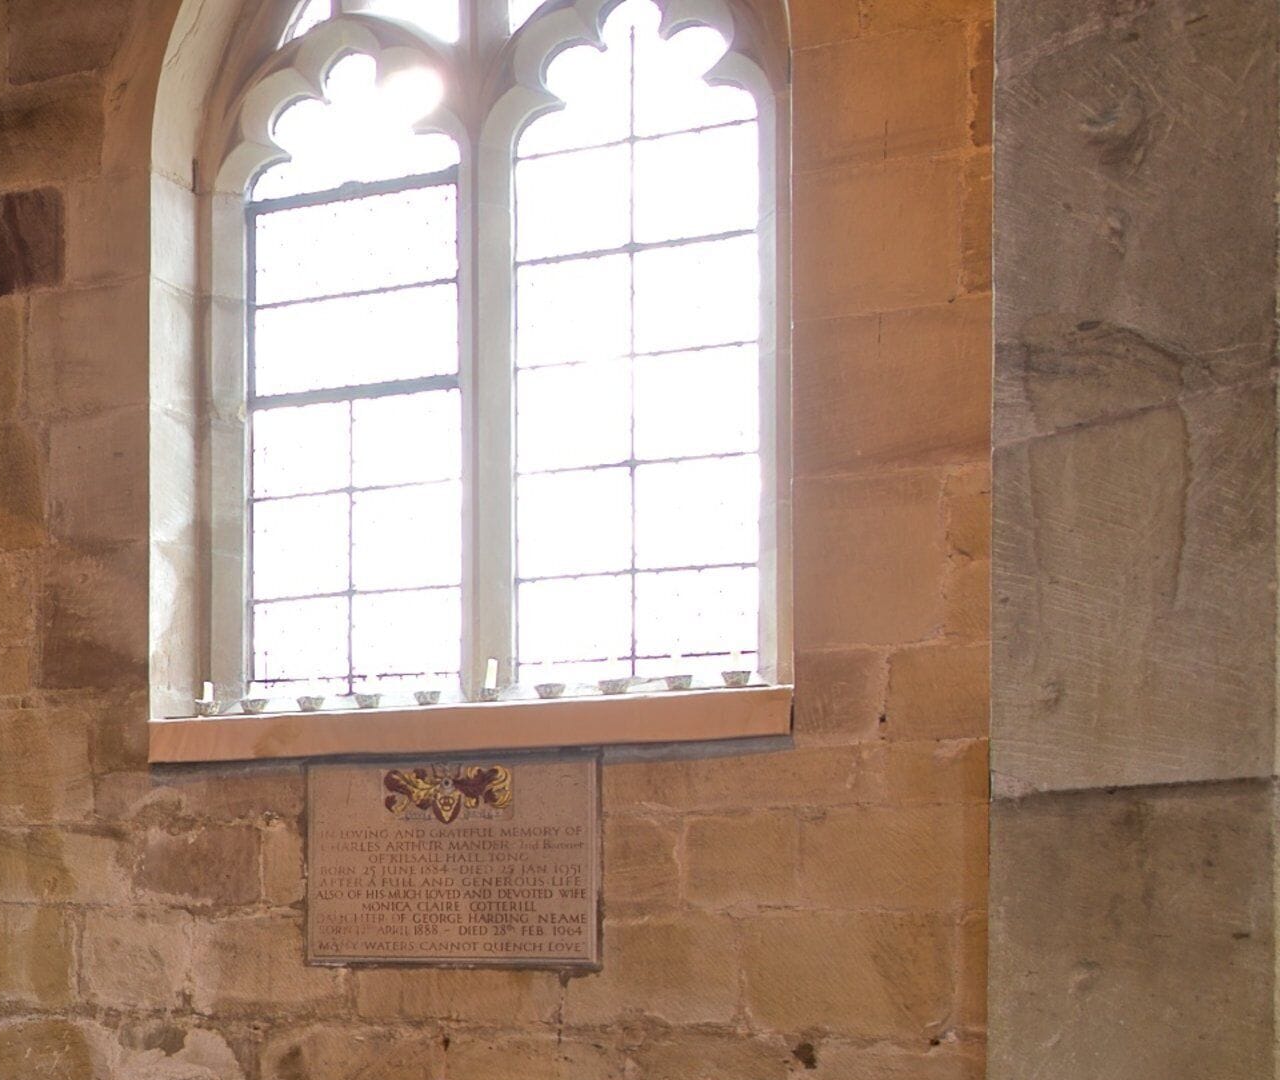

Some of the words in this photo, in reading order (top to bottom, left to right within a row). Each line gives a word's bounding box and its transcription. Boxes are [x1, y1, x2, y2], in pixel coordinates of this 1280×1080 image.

[340, 830, 389, 839] LOVING
[396, 829, 426, 839] AND
[430, 828, 494, 838] GRATEFUL
[500, 826, 560, 838] MEMORY
[565, 826, 582, 836] OF
[320, 842, 380, 852] CHARLES
[385, 841, 442, 852] ARTHUR
[448, 840, 510, 850] MANDER
[368, 854, 385, 864] OF
[390, 854, 440, 863] KILSALL
[446, 853, 482, 862] HALL
[320, 866, 356, 876] BORN
[364, 866, 377, 877] 25
[382, 866, 416, 876] JUNE
[420, 864, 448, 874] 1884
[460, 864, 493, 875] DIED
[522, 864, 547, 876] JAN
[554, 864, 582, 877] 1951
[320, 878, 362, 888] AFTER
[368, 878, 376, 887] A
[382, 878, 412, 887] FULL
[421, 877, 454, 887] AND
[462, 877, 545, 887] GENEROUS
[552, 876, 582, 887] LIFE
[316, 890, 344, 900] ALSO
[348, 890, 362, 900] OF
[366, 890, 384, 900] HIS
[388, 890, 420, 900] MUCH
[426, 889, 460, 900] LOVED
[463, 889, 492, 899] AND
[498, 888, 553, 899] DEVOTED
[558, 888, 586, 899] WIFE
[361, 902, 412, 912] MONICA
[416, 901, 460, 912] CLAIRE
[470, 901, 536, 912] COTTERILL
[318, 914, 385, 924] DAUGHTER
[392, 914, 406, 923] OF
[412, 914, 462, 924] GEORGE
[468, 913, 529, 924] HARDING
[537, 913, 588, 924] NEAME
[378, 925, 408, 936] APRIL
[414, 924, 438, 936] 1888
[458, 925, 488, 936] DIED
[522, 926, 544, 936] FEB
[552, 926, 583, 936] 1964
[365, 942, 414, 952] WATERS
[420, 942, 480, 952] CANNOT
[483, 942, 543, 953] QUENCH
